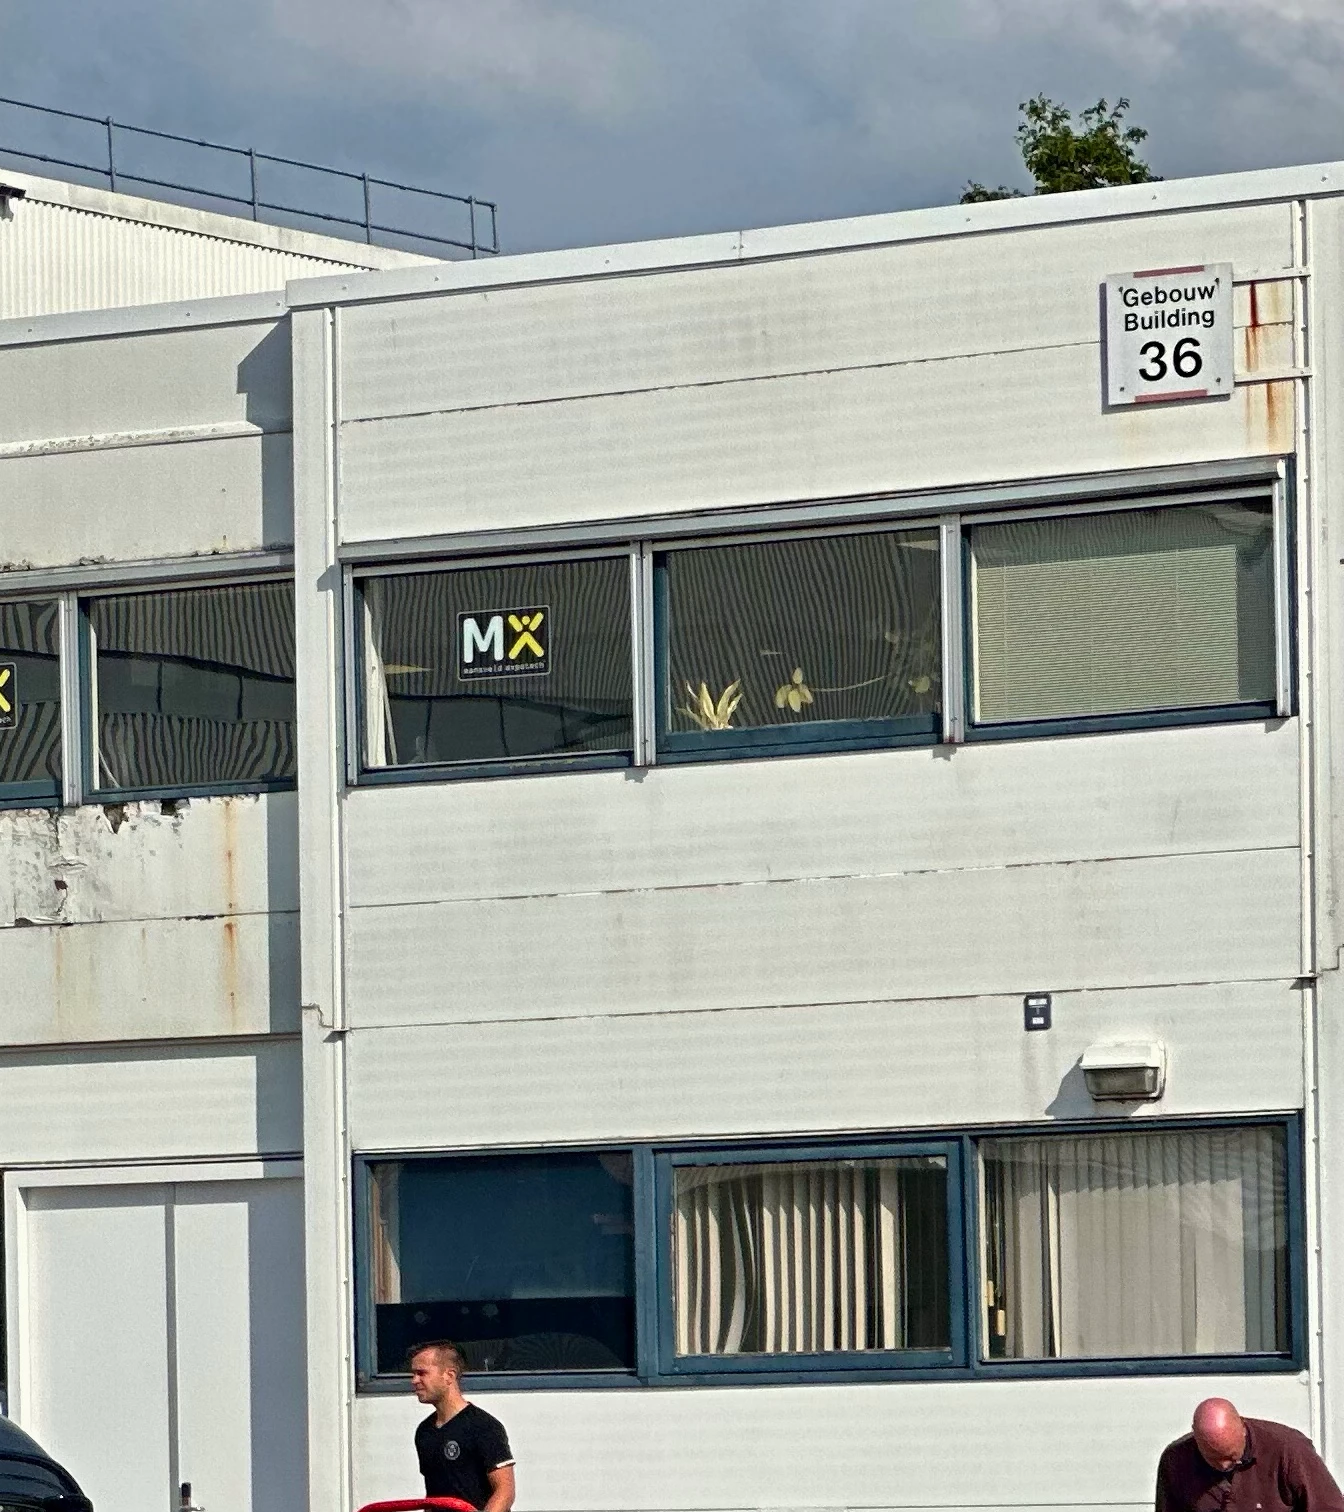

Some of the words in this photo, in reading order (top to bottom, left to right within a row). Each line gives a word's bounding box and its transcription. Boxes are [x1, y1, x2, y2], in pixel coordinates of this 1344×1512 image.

[1123, 284, 1215, 307] Gebouw
[1124, 308, 1215, 332] Building
[1138, 337, 1203, 382] 36
[463, 612, 545, 664] MX
